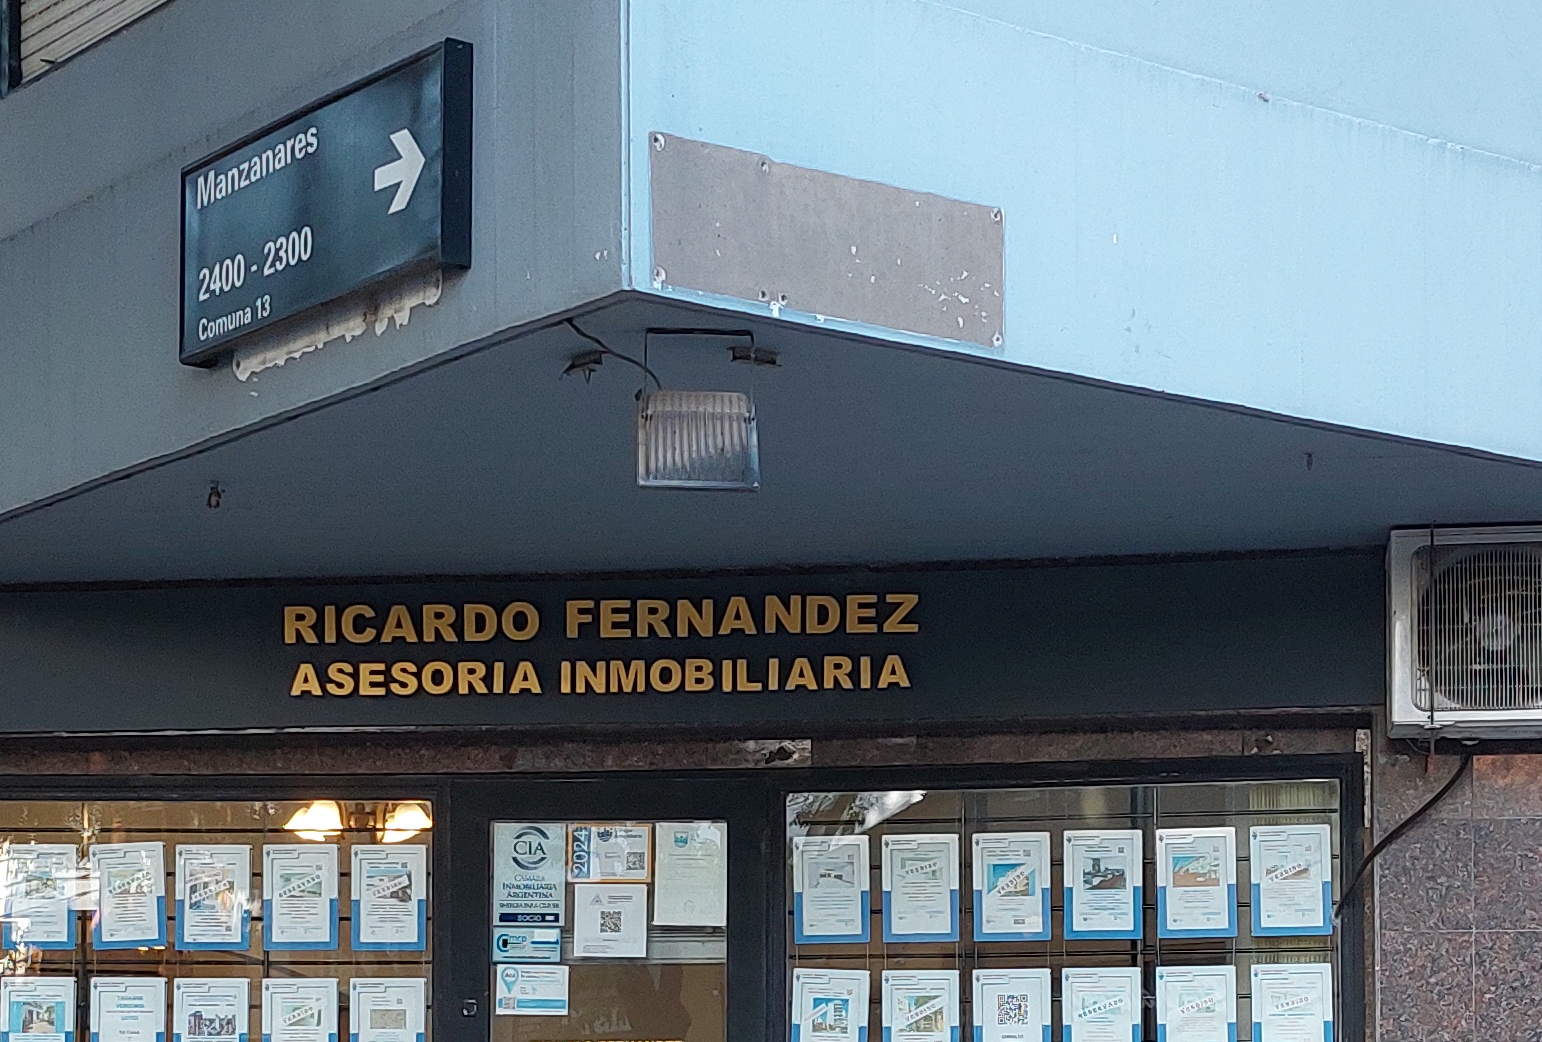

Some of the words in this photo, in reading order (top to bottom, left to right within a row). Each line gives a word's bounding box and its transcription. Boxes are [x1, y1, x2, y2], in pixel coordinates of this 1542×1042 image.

[196, 125, 318, 210] Manzanares
[198, 253, 246, 302] 2400
[263, 226, 313, 277] 2300
[198, 305, 252, 341] Comuna
[255, 294, 271, 320] 13
[282, 601, 541, 645] RICARDO
[565, 593, 920, 639] FERNANDEZ
[289, 660, 543, 697] ASESORIA
[559, 653, 912, 695] INMOBILIARIA
[513, 840, 547, 856] CIA
